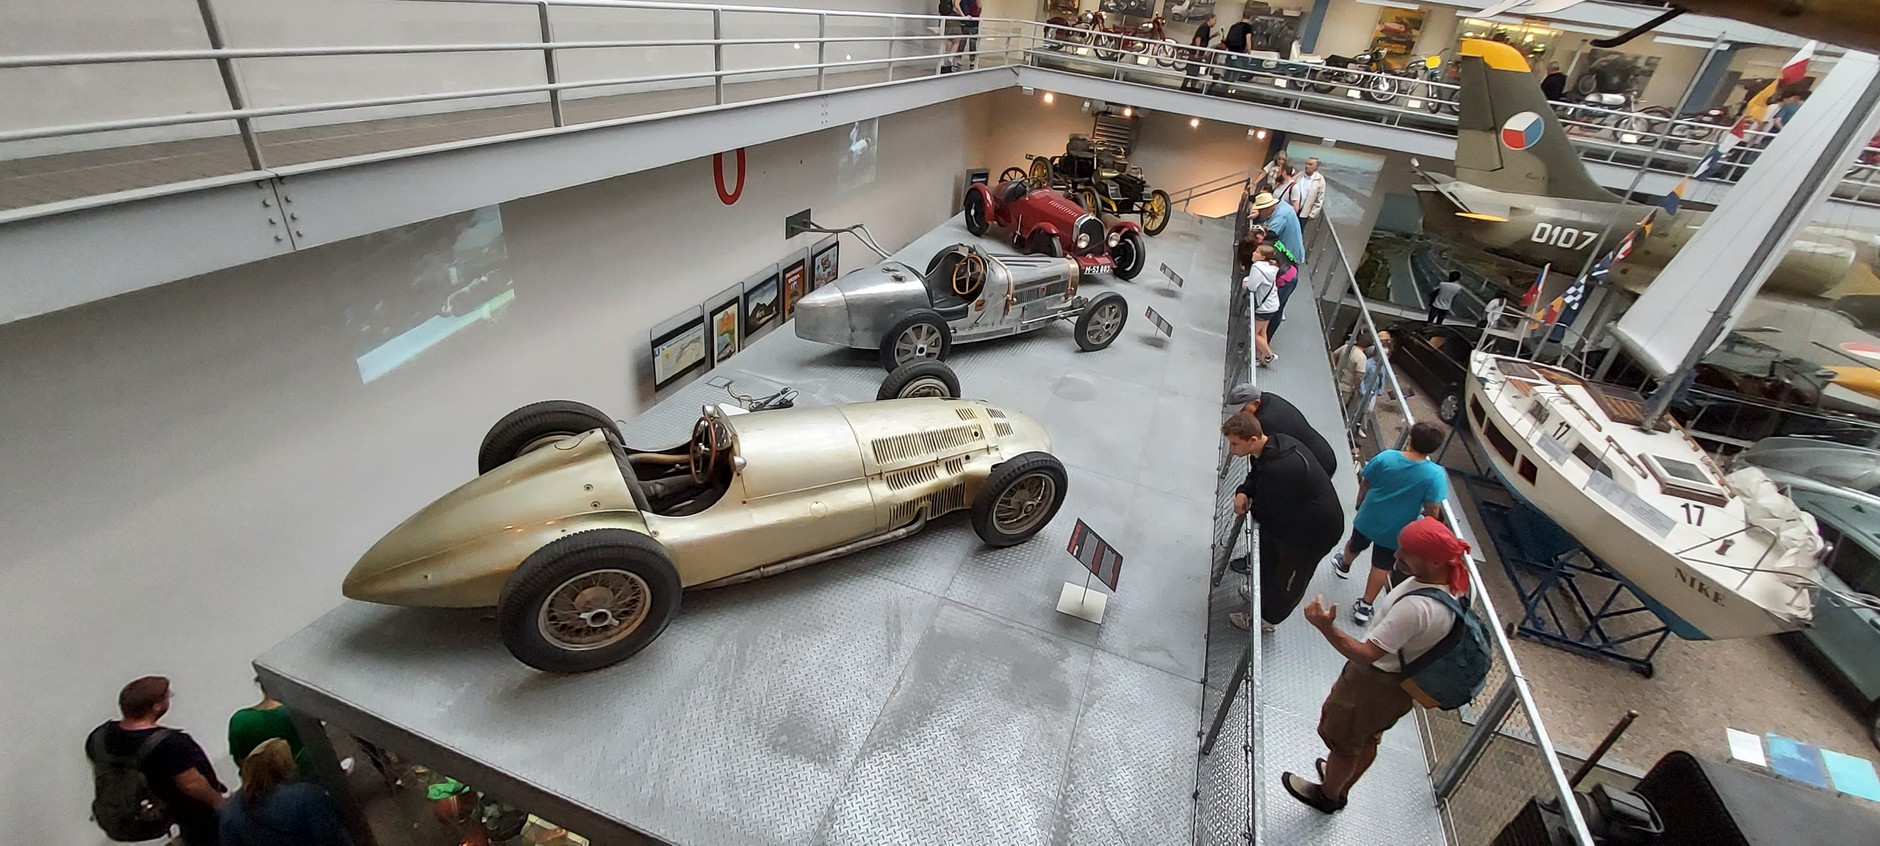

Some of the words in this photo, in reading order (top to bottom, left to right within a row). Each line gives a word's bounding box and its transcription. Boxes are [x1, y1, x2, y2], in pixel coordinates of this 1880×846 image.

[1531, 222, 1599, 250] 0107
[1552, 420, 1571, 440] 17
[1680, 502, 1705, 527] 17
[1674, 567, 1726, 608] NIKE
